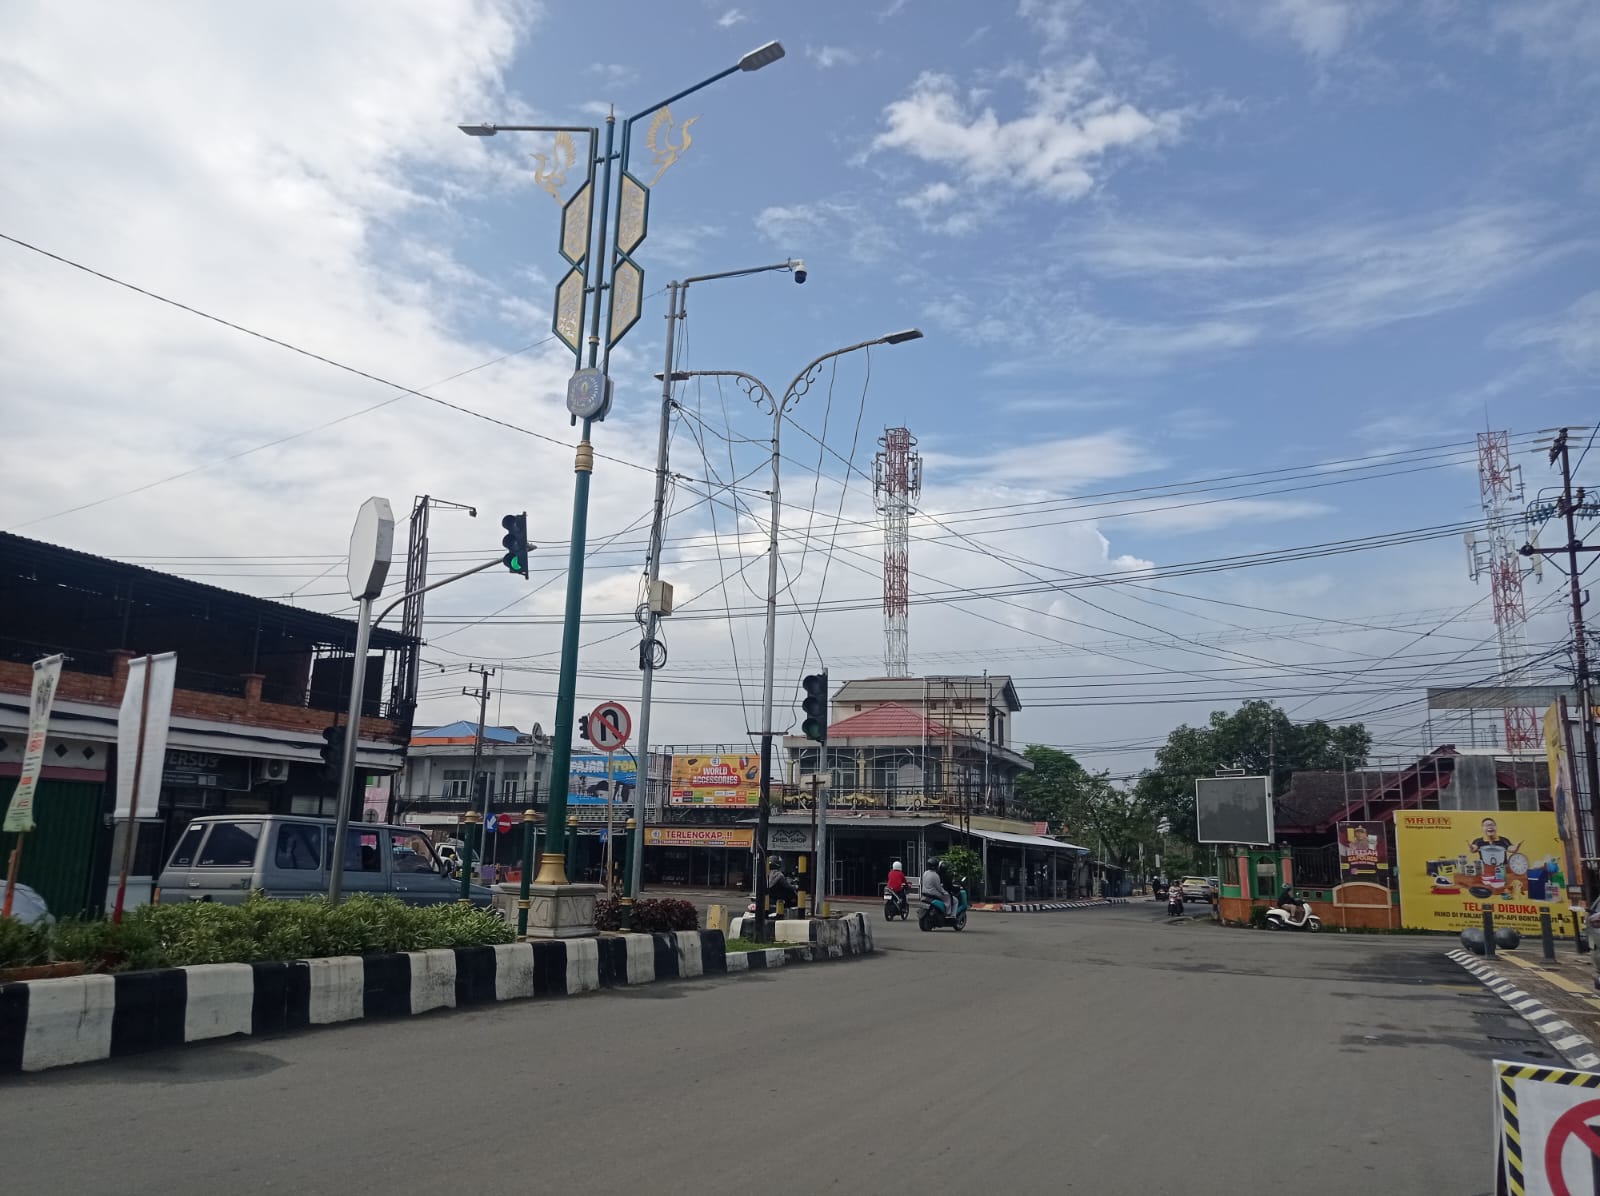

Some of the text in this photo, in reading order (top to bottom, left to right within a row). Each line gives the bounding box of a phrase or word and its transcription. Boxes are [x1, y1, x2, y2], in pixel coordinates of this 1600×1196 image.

[703, 767, 728, 776] WORLD
[692, 775, 739, 785] ACCESSORIES
[1498, 904, 1538, 915] DIBUKA
